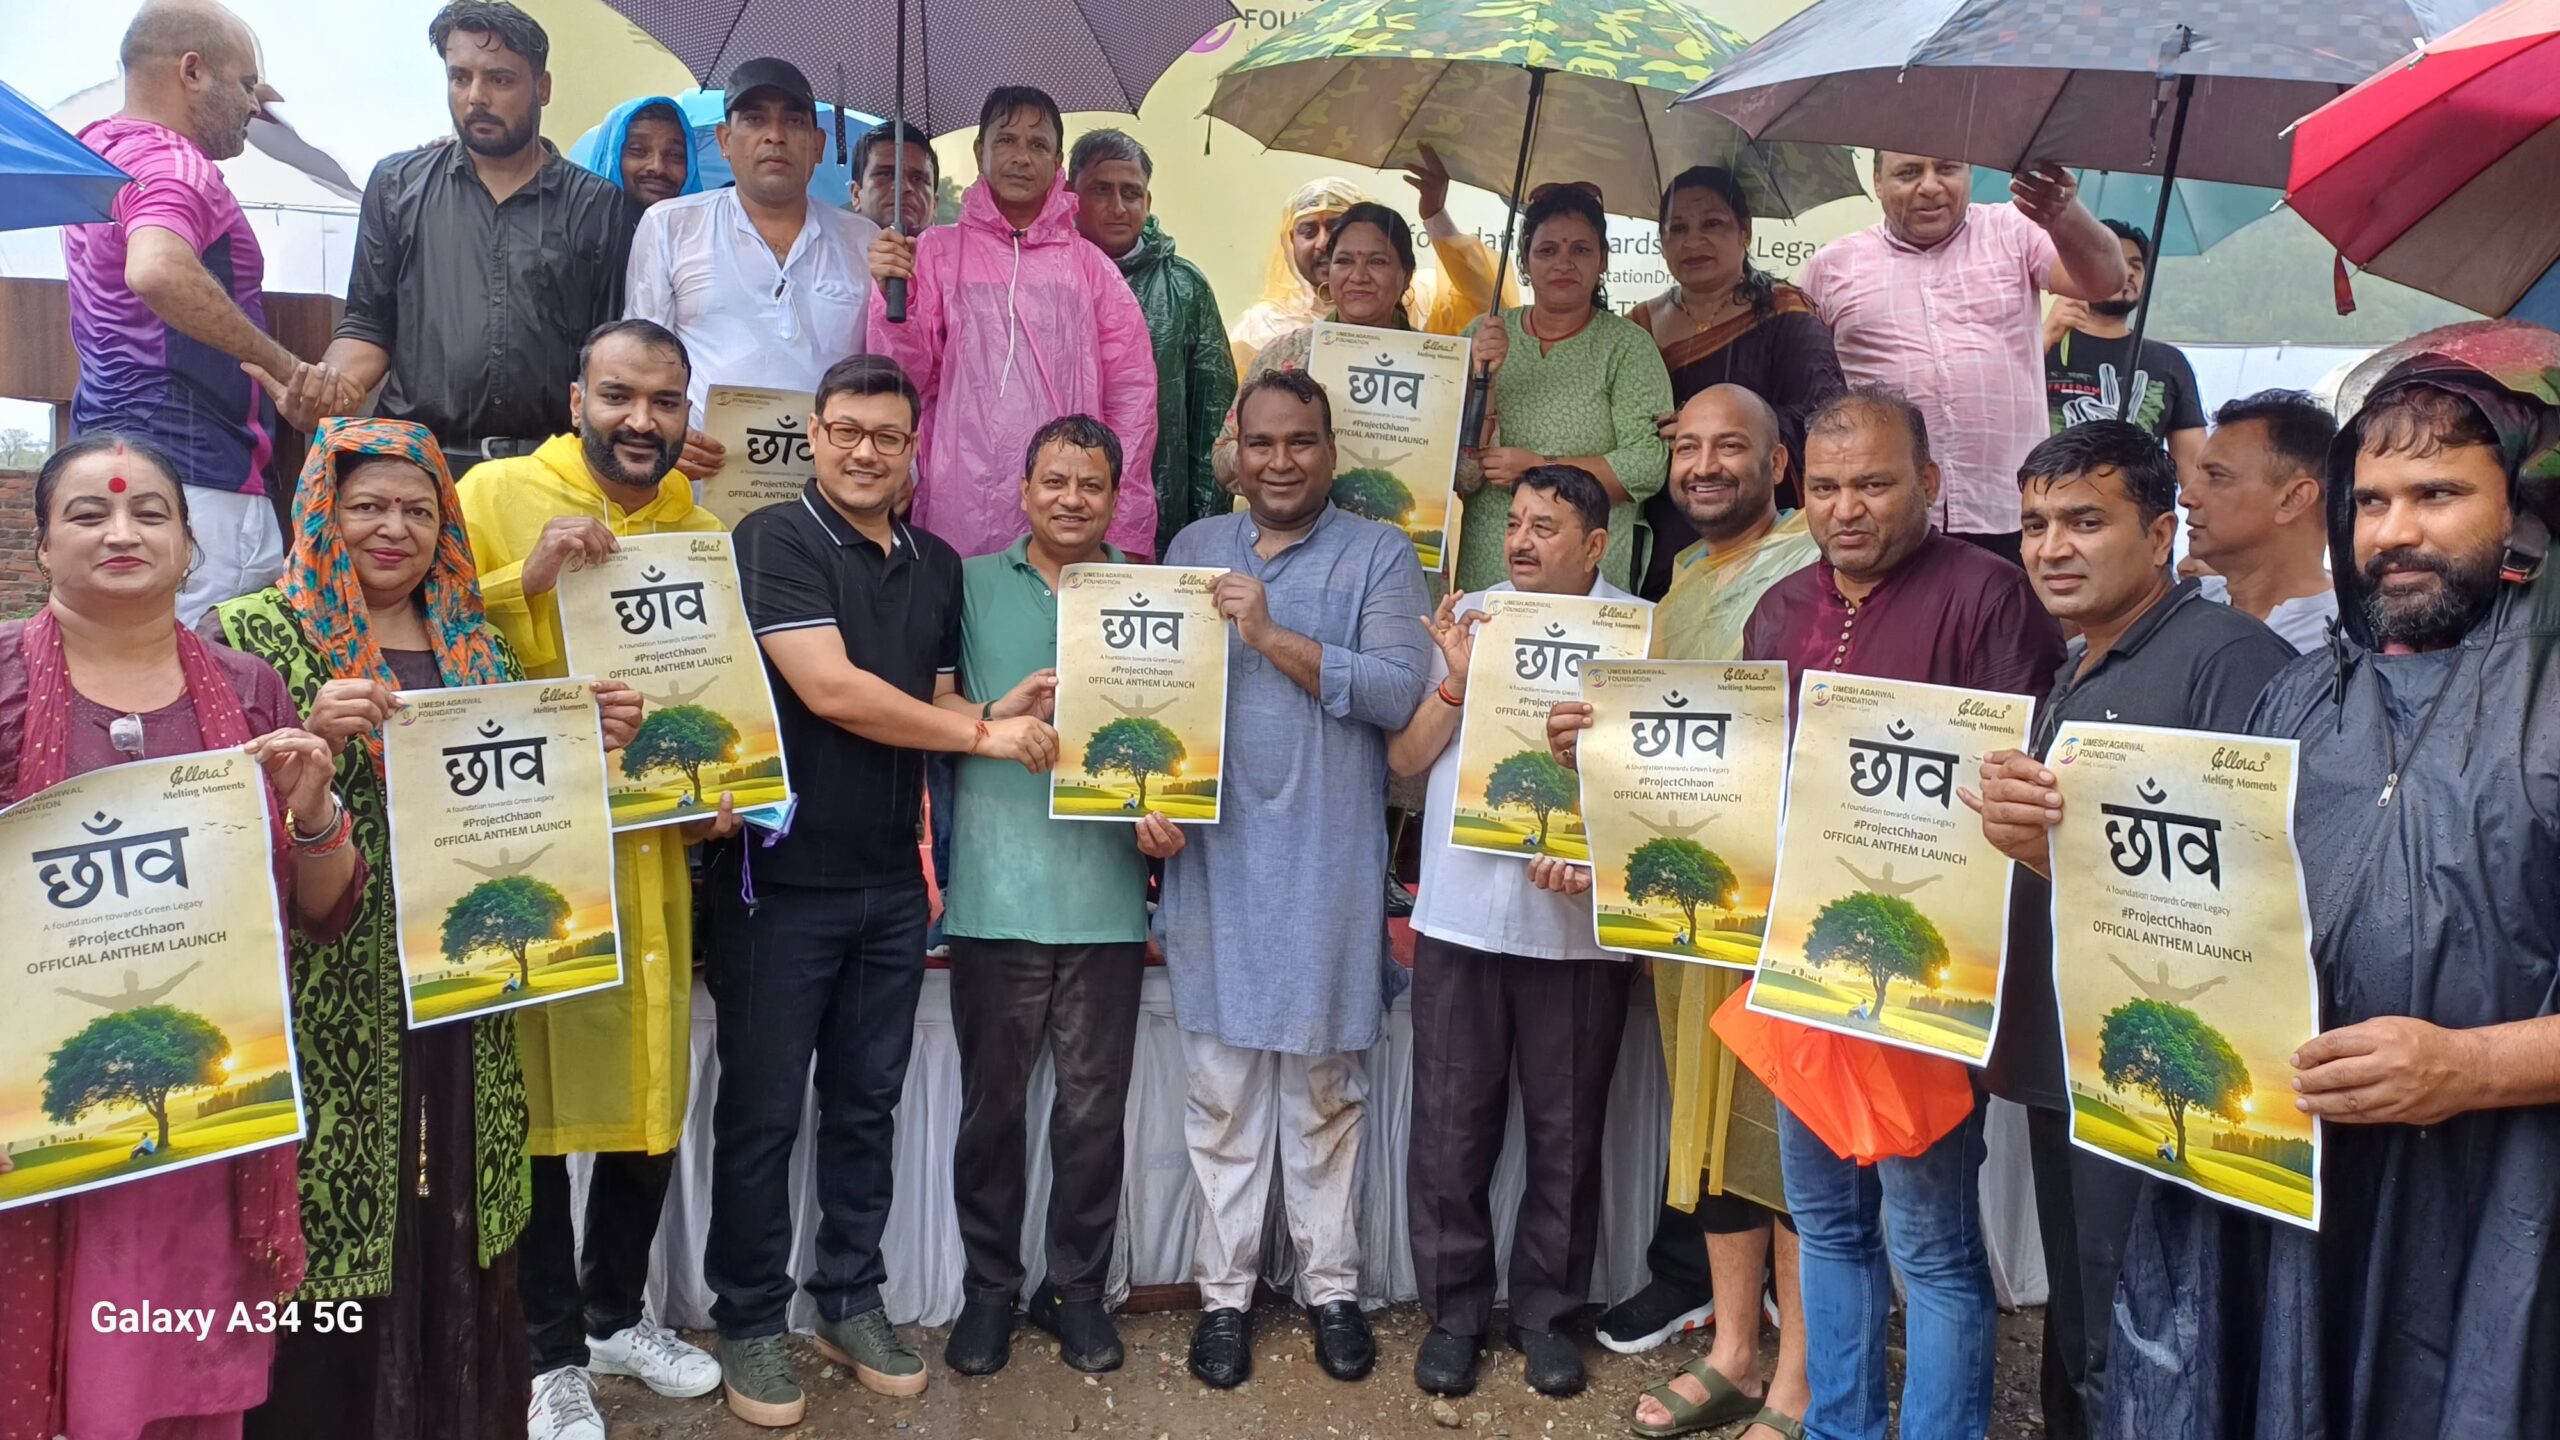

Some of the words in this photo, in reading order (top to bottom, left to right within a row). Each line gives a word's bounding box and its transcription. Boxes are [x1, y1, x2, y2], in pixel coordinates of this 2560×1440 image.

[1608, 232, 1662, 256] ards
[1757, 236, 1826, 267] Lega
[1348, 352, 1425, 411] छाँव
[1364, 431, 1397, 442] ANTHEM
[1398, 435, 1429, 446] LAUNCH
[750, 479, 806, 489] #ProjectChha
[728, 490, 762, 499] OFFICIAL
[764, 491, 798, 499] ANTHEM
[610, 564, 708, 635] छाँव
[1503, 606, 1539, 615] FOUNDATION
[1100, 592, 1184, 652] छाँव
[634, 646, 708, 664] #ProjectChhaon
[608, 666, 653, 680] OFFICIAL
[654, 661, 696, 675] ANTHEM
[697, 655, 733, 668] LAUNCH
[1111, 665, 1173, 677] #ProjectChhaon
[1088, 676, 1124, 686] OFFICIAL
[1125, 678, 1161, 688] ANTHEM
[1162, 678, 1195, 689] LAUNCH
[1607, 675, 1652, 683] FOUNDATION
[1717, 683, 1743, 692] Melting
[1745, 683, 1776, 692] Moments
[1831, 694, 1879, 707] FOUNDATION
[1832, 684, 1858, 695] UMESH
[1859, 688, 1896, 700] AGARWAL
[417, 699, 445, 709] UMESH
[418, 707, 467, 718] FOUNDATION
[532, 704, 558, 715] Melting
[559, 702, 588, 712] Moments
[1495, 706, 1531, 718] OFFICIAL
[1532, 709, 1550, 719] ANT
[1629, 689, 1732, 760] छाँव
[1948, 718, 1977, 731] Melting
[1979, 723, 2015, 735] Moments
[2083, 737, 2107, 749] UMESH
[2107, 740, 2145, 753] AGARWAL
[442, 718, 547, 797] छाँव
[1849, 718, 1960, 810] छाँव
[2078, 748, 2127, 763] FOUNDATION
[163, 787, 200, 801] Melting
[202, 780, 246, 795] Moments
[1638, 777, 1714, 789] #ProjectChhaon
[2202, 773, 2234, 790] Melting
[2237, 778, 2277, 792] Moments
[452, 802, 487, 813] foundation
[488, 799, 513, 808] towards
[514, 796, 532, 805] Green
[534, 794, 555, 804] Legacy
[1613, 790, 1654, 801] OFFICIAL
[1655, 791, 1698, 801] ANTHEM
[1700, 792, 1742, 803] LAUNCH
[0, 800, 61, 819] OUNDATION
[1847, 803, 1882, 816] foundation
[1883, 809, 1910, 821] towards
[1911, 813, 1932, 823] Green
[1933, 817, 1957, 829] Legacy
[462, 810, 542, 829] #ProjectChhaon
[434, 833, 482, 848] OFFICIAL
[484, 825, 528, 840] ANTHEM
[530, 819, 572, 834] LAUNCH
[1853, 819, 1938, 843] #ProjectChhaon
[2101, 776, 2222, 892] छाँव
[1822, 829, 1869, 848] OFFICIAL
[1871, 840, 1919, 857] ANTHEM
[1921, 847, 1968, 866] LAUNCH
[32, 810, 189, 909] छाँव
[2111, 885, 2149, 902] foundation
[2150, 891, 2179, 907] towards
[2180, 898, 2202, 911] Green
[2203, 903, 2231, 917] Legacy
[52, 914, 103, 931] foundation
[105, 908, 143, 921] towards
[144, 904, 171, 915] Green
[173, 899, 203, 911] Legacy
[2121, 906, 2212, 936] #ProjectChhaon
[68, 921, 185, 948] #ProjectChhaon
[2092, 920, 2141, 943] OFFICIAL
[2142, 931, 2193, 954] ANTHEM
[2196, 942, 2253, 963] LAUNCH
[26, 953, 97, 975] OFFICIAL
[100, 941, 165, 963] ANTHEM
[169, 930, 227, 950] LAUNCH
